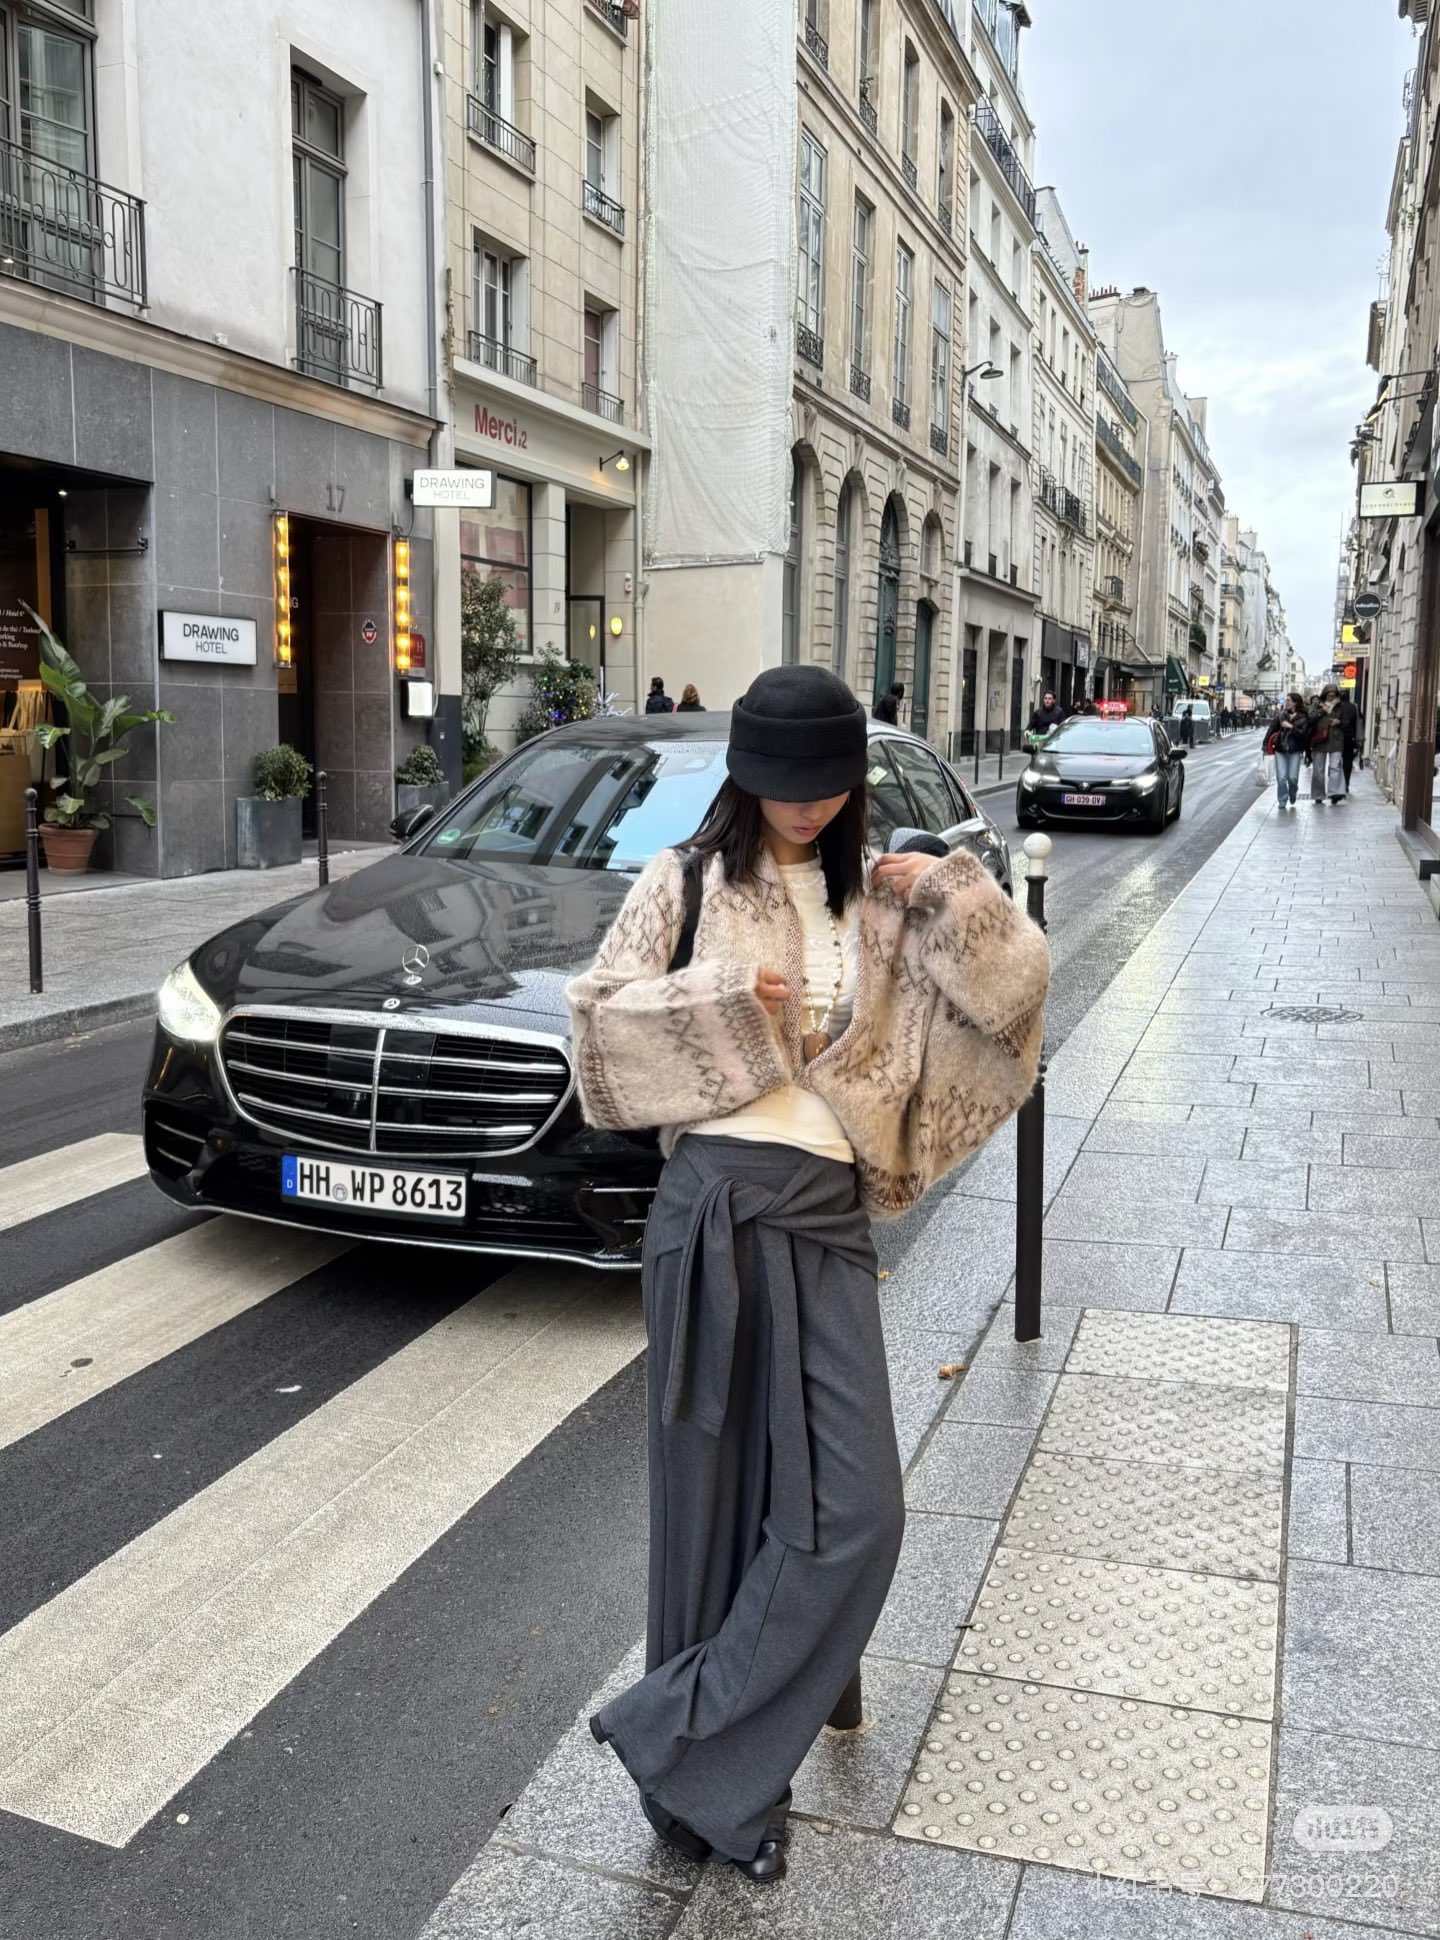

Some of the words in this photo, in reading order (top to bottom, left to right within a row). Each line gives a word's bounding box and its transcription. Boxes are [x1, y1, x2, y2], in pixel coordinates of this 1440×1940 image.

[475, 404, 517, 446] Merci
[420, 476, 485, 489] DRAWING
[326, 483, 345, 513] 17
[433, 490, 470, 500] HOTEL
[183, 623, 239, 642] DRAWING
[195, 641, 228, 654] HOTEL
[286, 1178, 293, 1189] D
[300, 1162, 330, 1196] HH
[351, 1169, 385, 1203] WP
[392, 1174, 463, 1212] 8613
